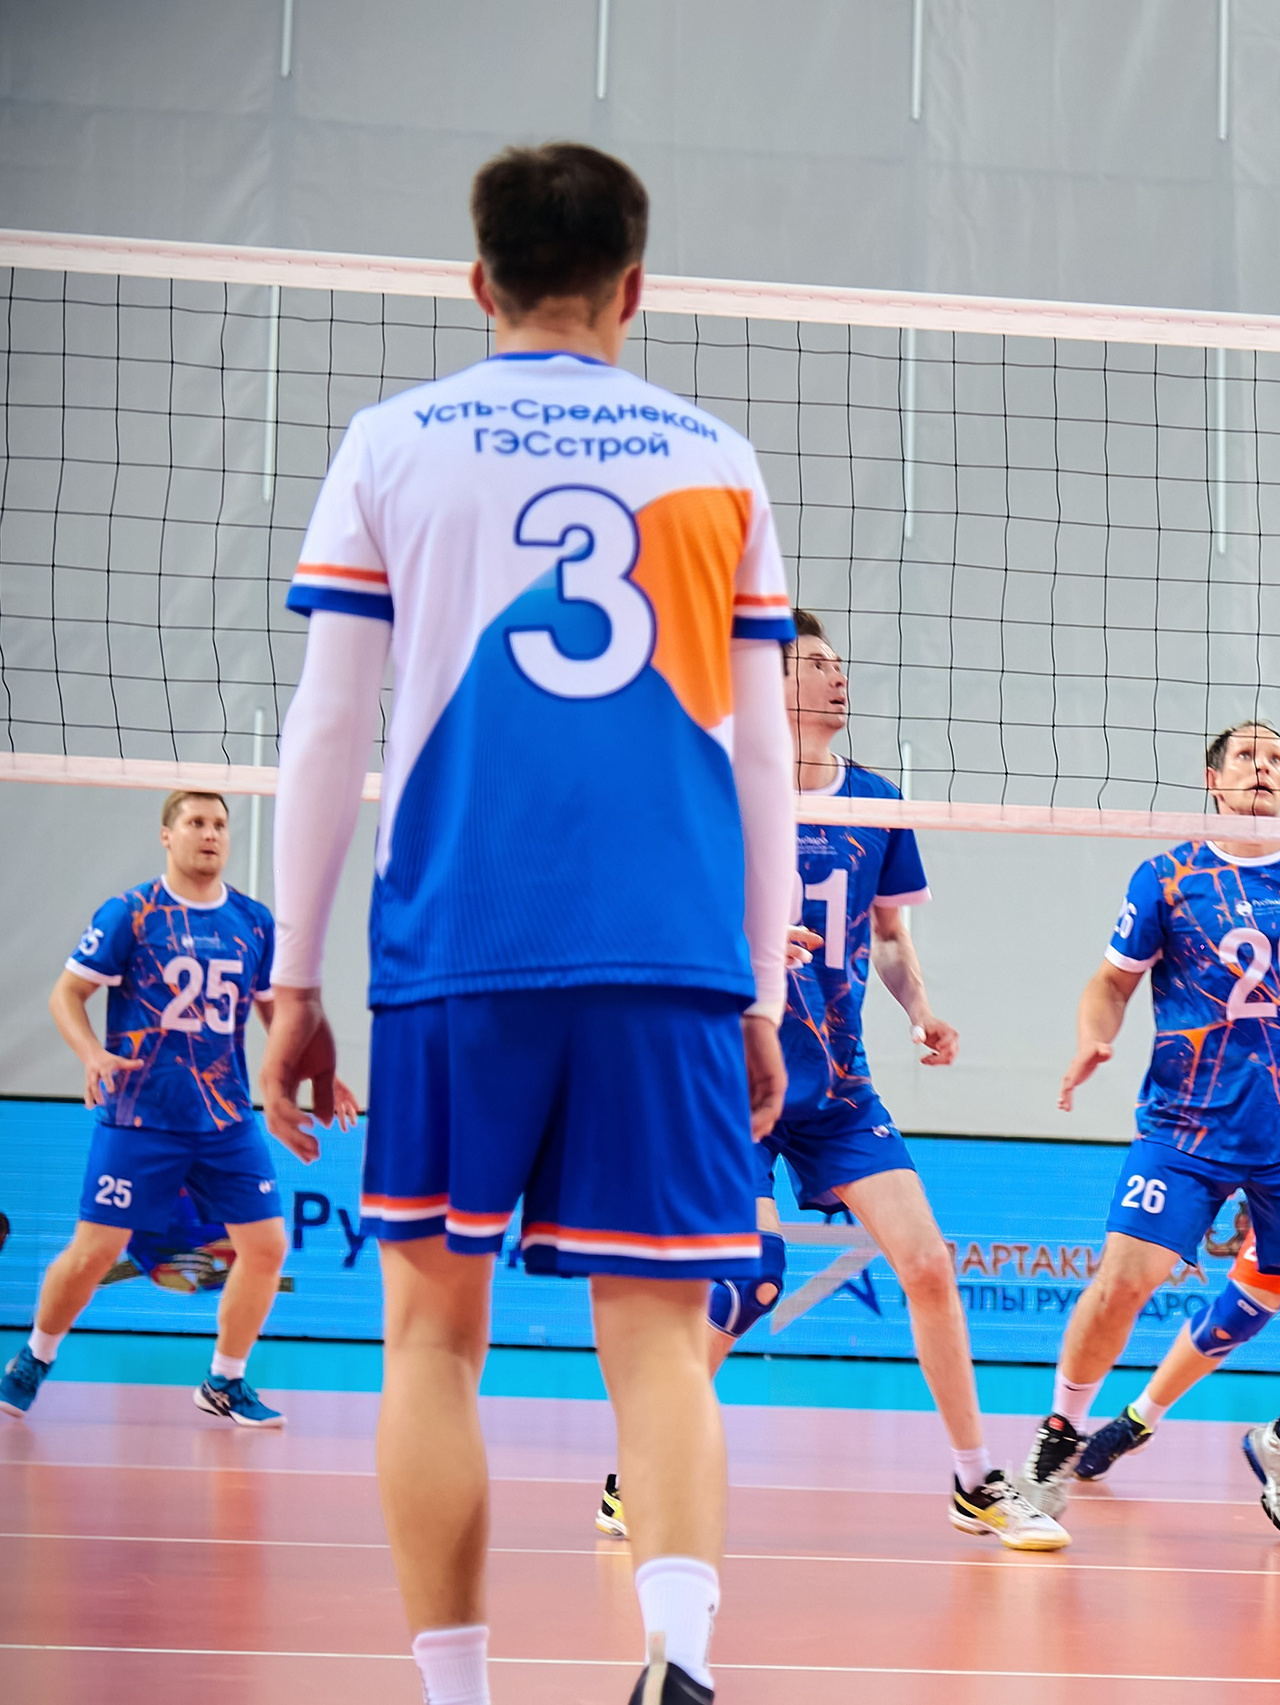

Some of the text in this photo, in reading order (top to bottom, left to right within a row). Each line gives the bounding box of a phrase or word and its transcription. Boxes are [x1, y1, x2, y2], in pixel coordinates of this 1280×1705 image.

[414, 399, 719, 443] Усть-Среднекан
[473, 427, 671, 462] ГЭСстрой
[504, 482, 658, 700] 3
[789, 867, 848, 970] 1
[161, 956, 244, 1035] 25
[96, 1174, 132, 1209] 25
[1121, 1174, 1169, 1215] 26
